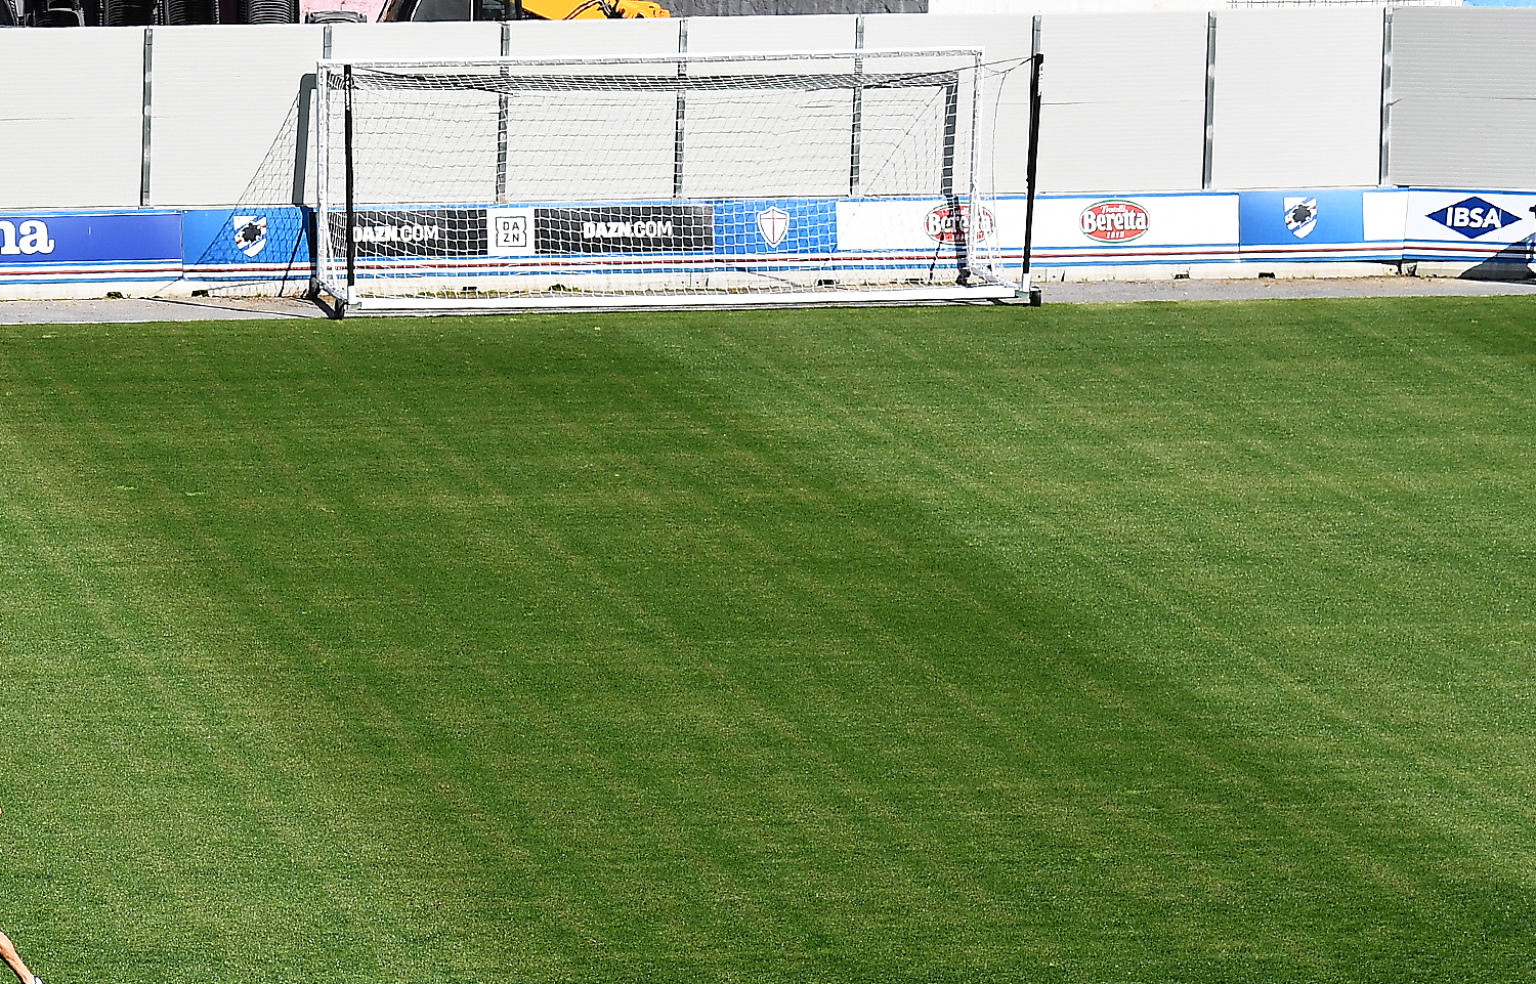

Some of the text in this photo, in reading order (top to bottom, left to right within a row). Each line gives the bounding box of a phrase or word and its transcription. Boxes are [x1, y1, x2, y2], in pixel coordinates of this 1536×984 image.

[1083, 209, 1146, 233] Beretta
[1445, 206, 1502, 228] IBSA
[352, 224, 440, 243] DAZN.COM
[582, 220, 674, 239] DAZN.COM
